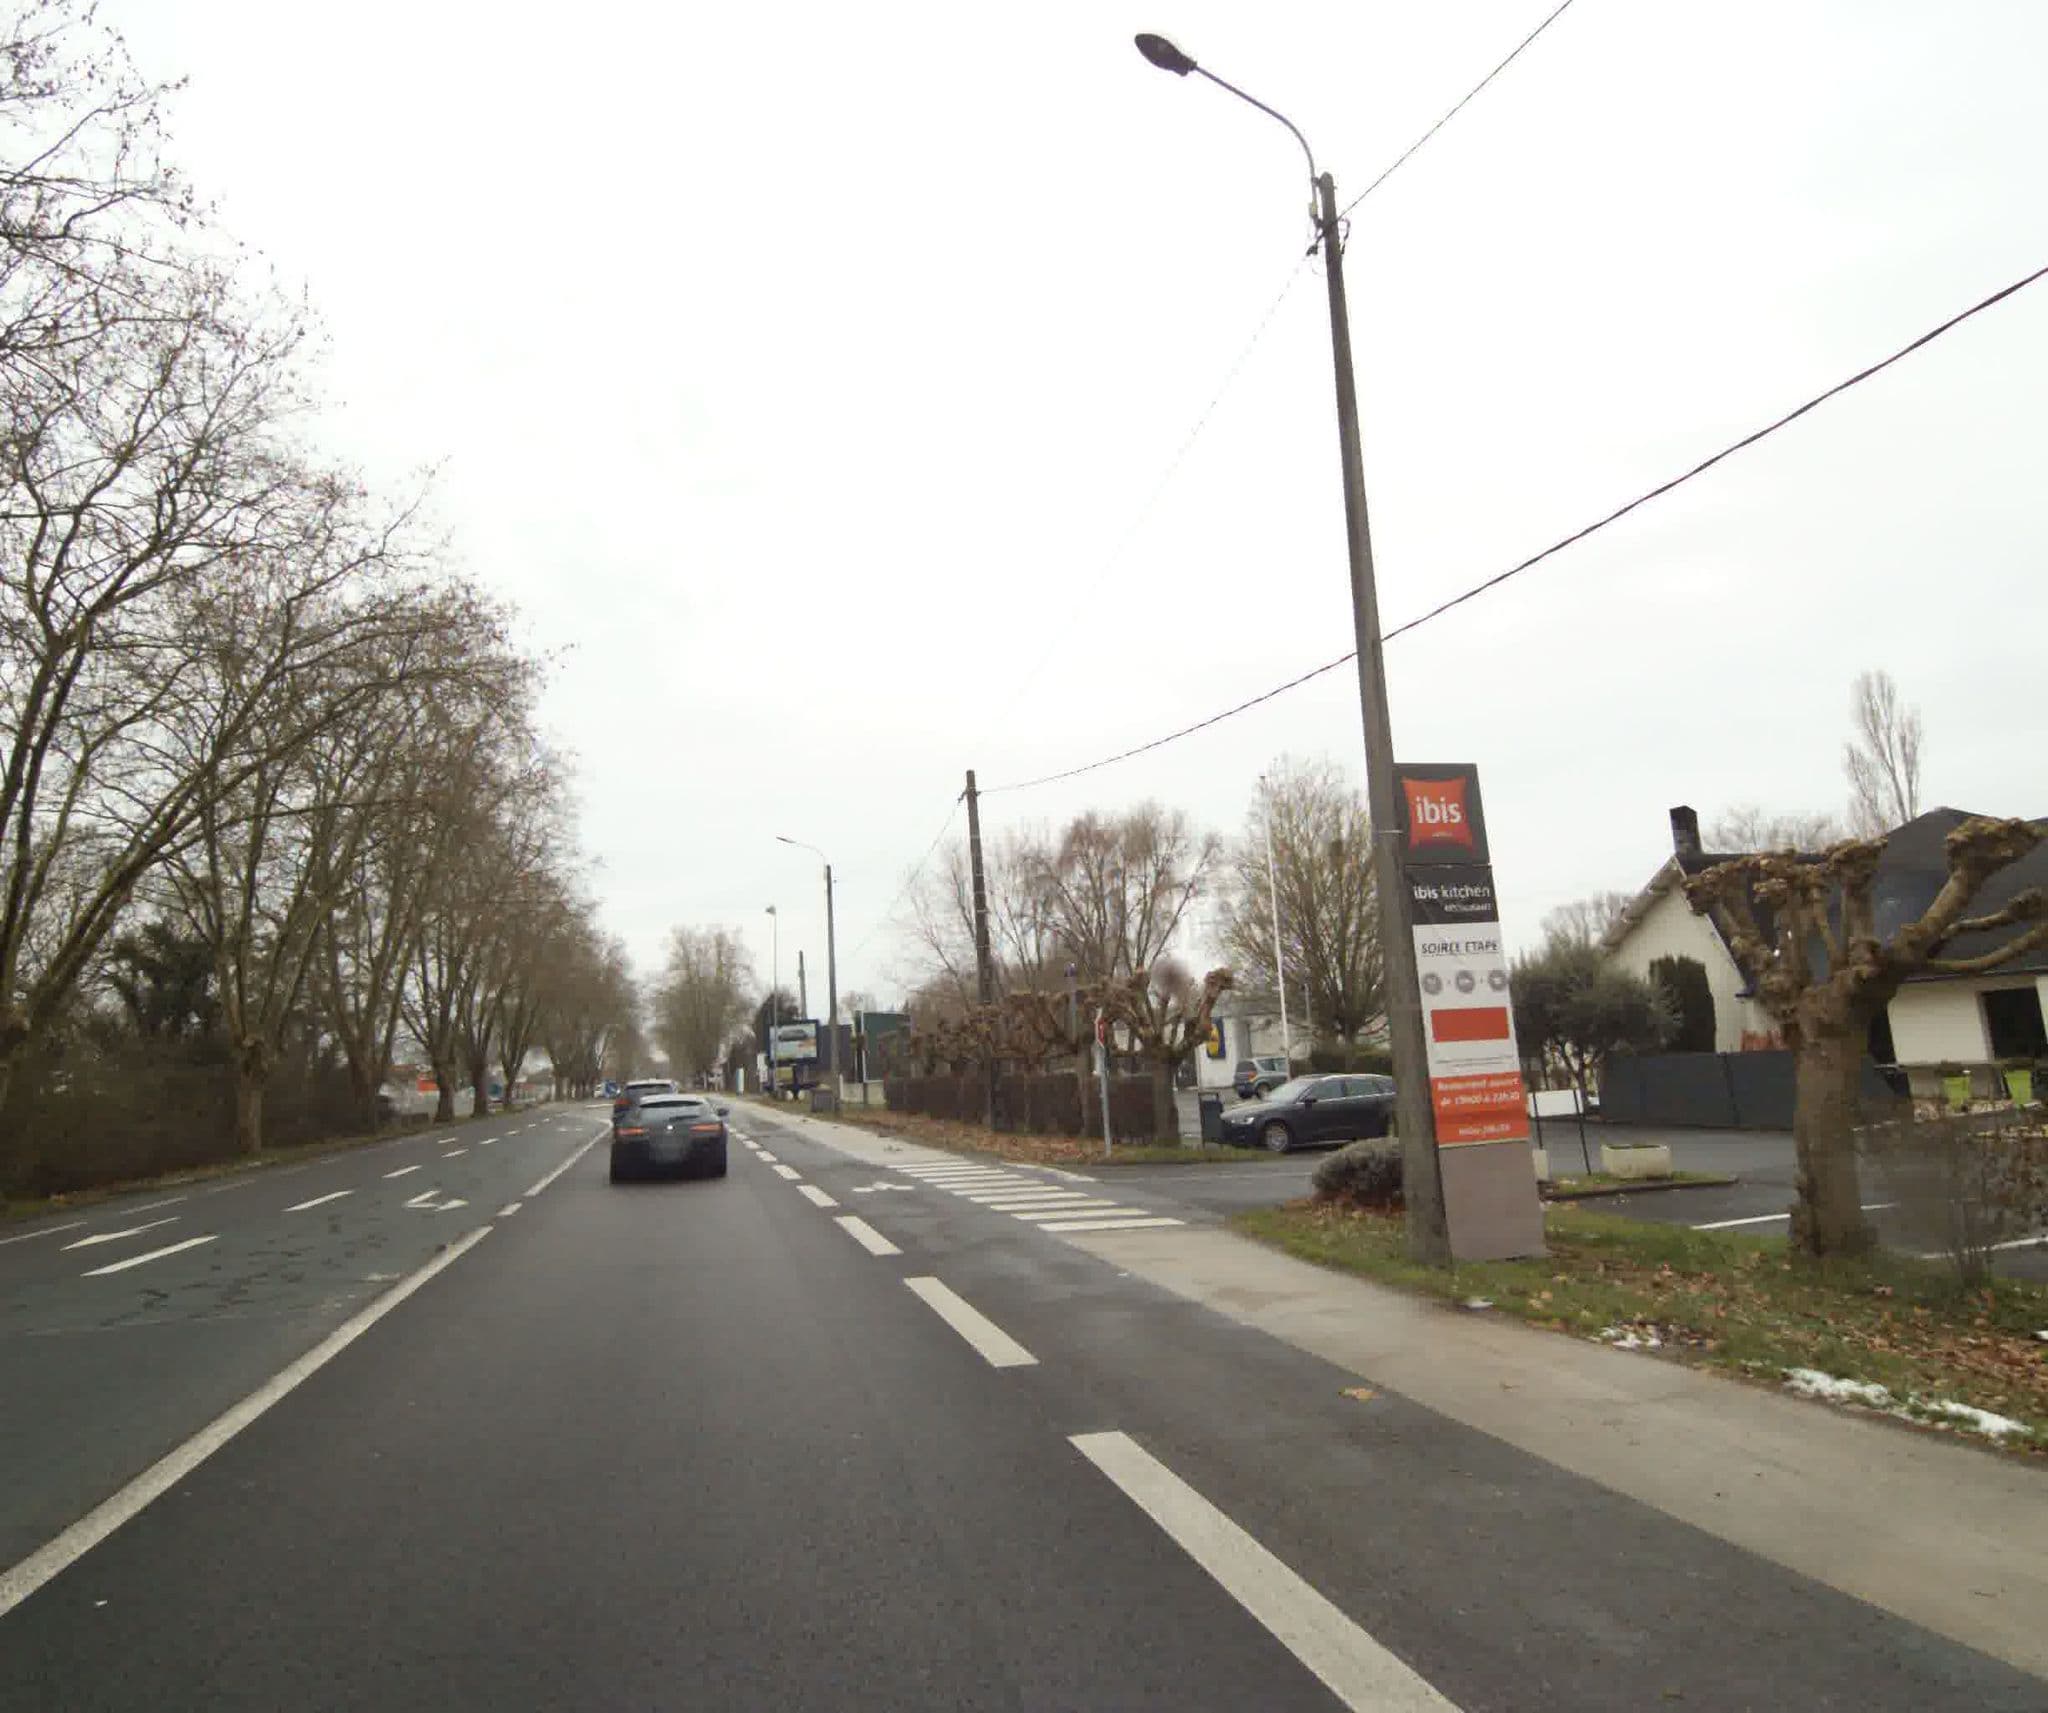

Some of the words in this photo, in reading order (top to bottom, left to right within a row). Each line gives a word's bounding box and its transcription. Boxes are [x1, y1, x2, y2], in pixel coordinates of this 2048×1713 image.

[1415, 796, 1462, 824] ibis
[1413, 884, 1438, 900] ibis
[1440, 883, 1490, 899] kitchen
